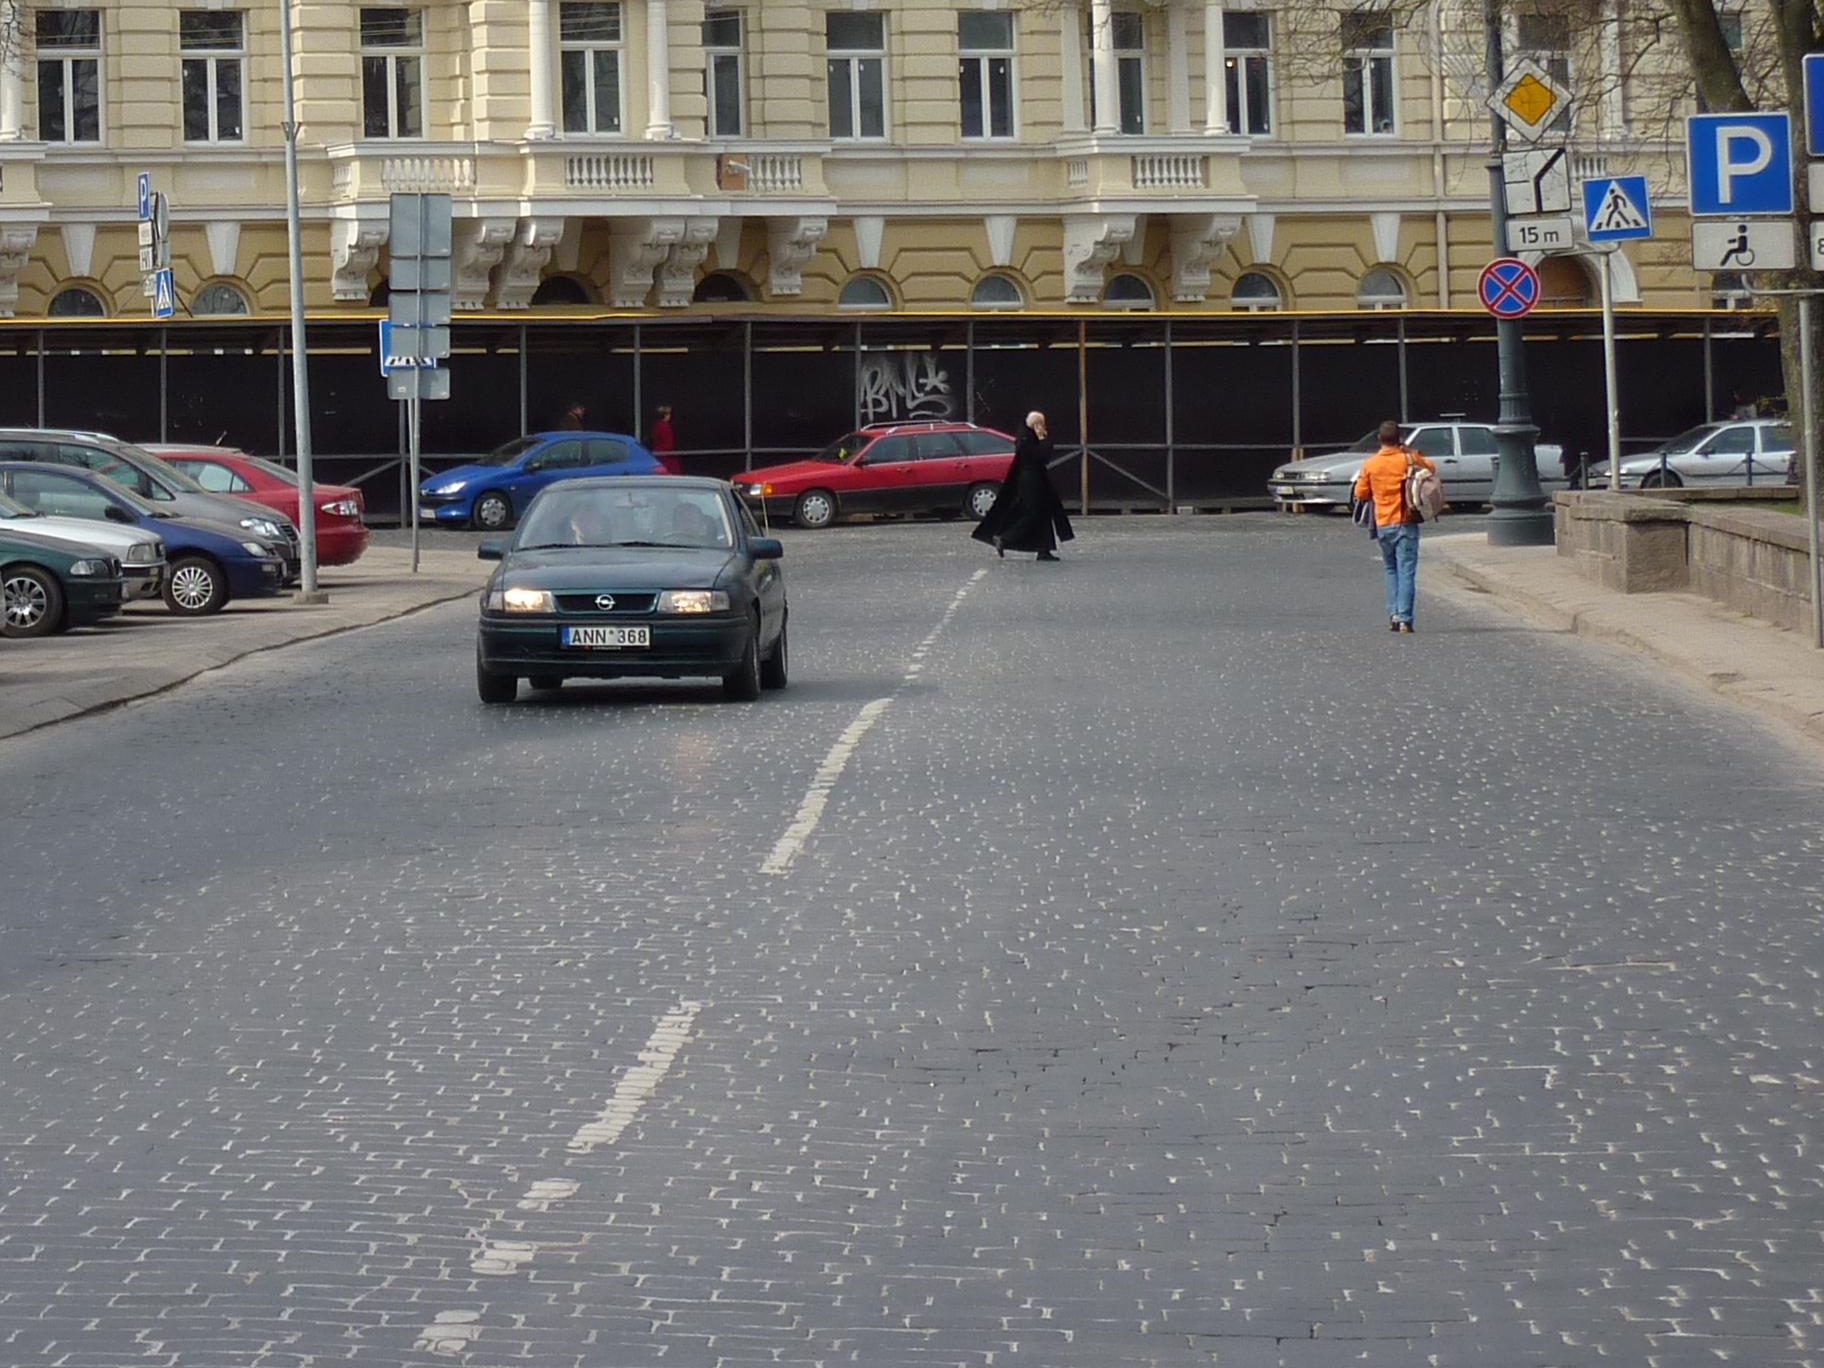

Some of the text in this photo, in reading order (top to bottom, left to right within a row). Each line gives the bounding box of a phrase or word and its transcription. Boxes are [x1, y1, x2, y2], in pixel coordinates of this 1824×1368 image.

[1716, 125, 1772, 204] P
[140, 178, 148, 215] P
[1519, 226, 1559, 244] 15 m
[572, 629, 606, 644] ANN
[617, 629, 647, 644] 368
